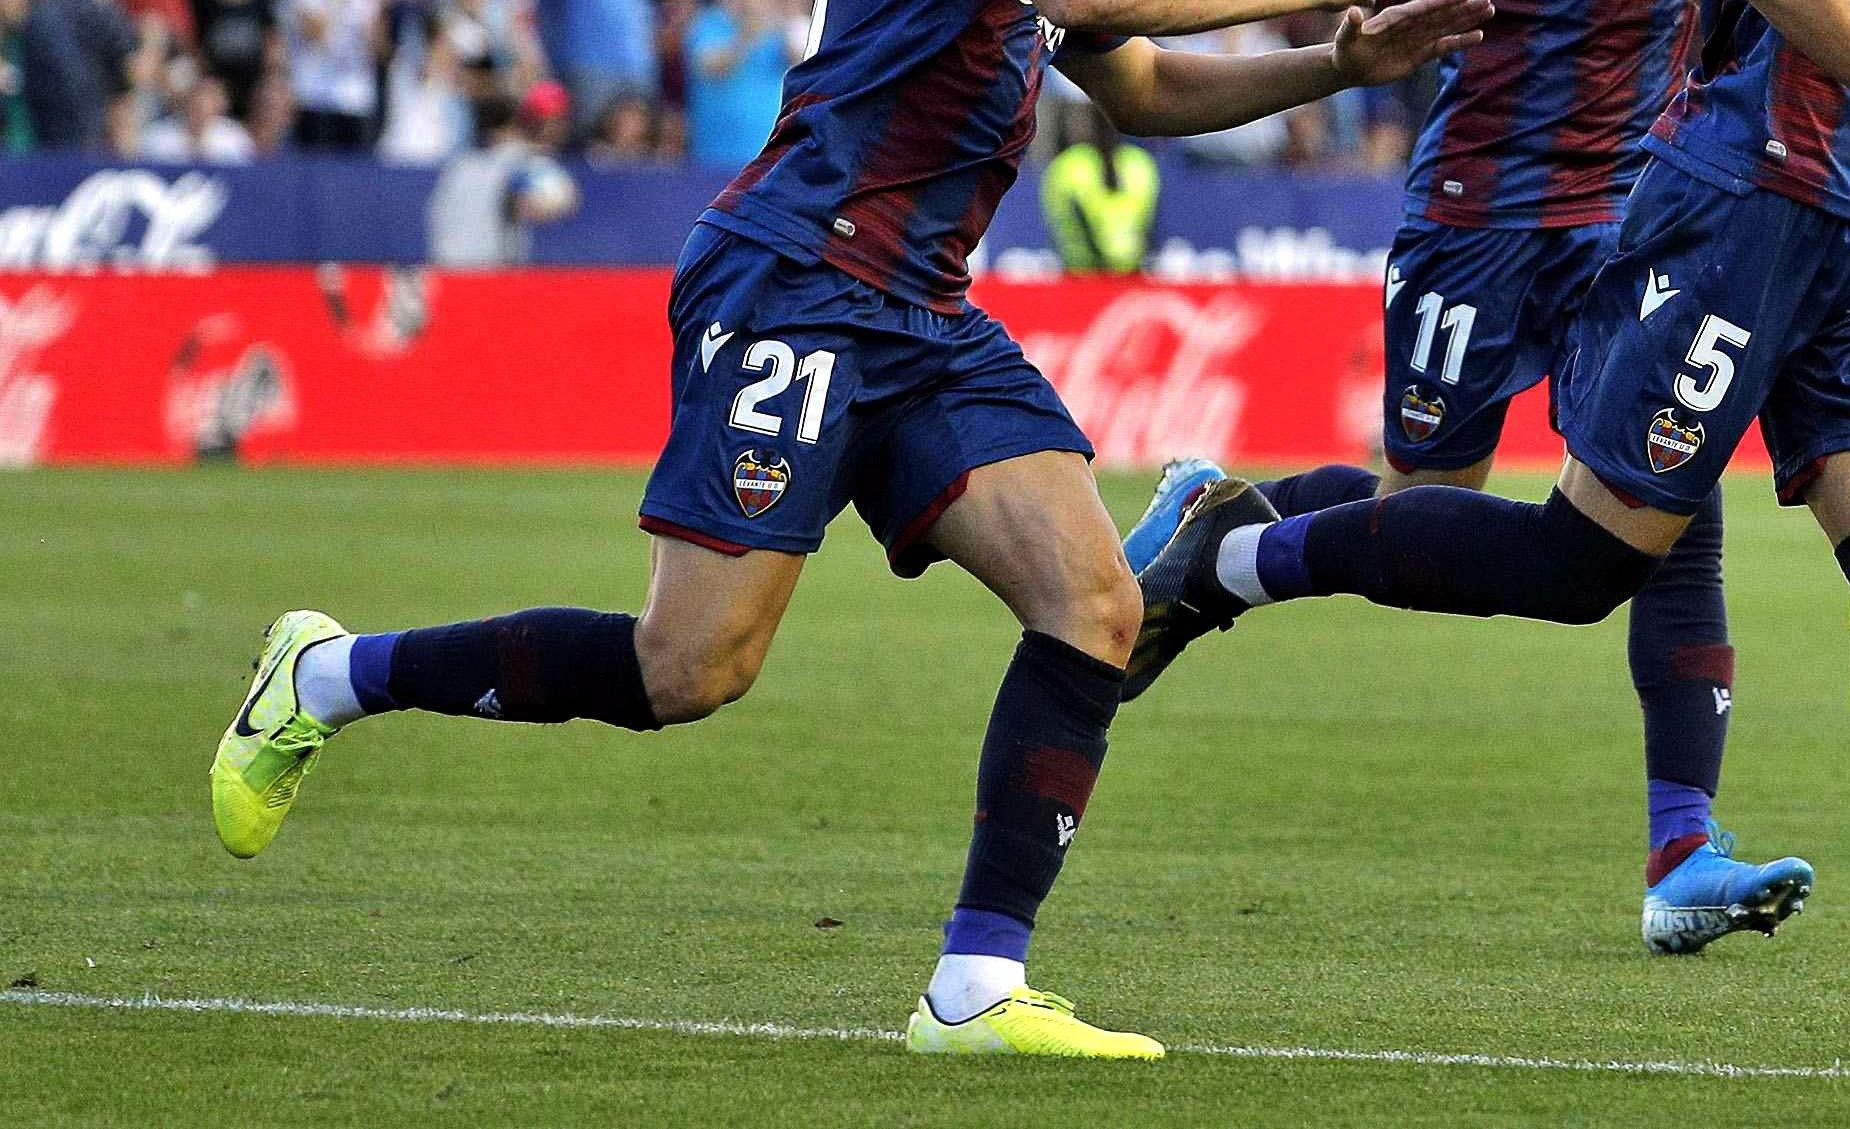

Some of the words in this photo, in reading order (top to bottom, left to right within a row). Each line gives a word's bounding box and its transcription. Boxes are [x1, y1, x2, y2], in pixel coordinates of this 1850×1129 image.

[1409, 289, 1478, 386] 11
[1672, 313, 1752, 413] 5
[728, 338, 837, 445] 21
